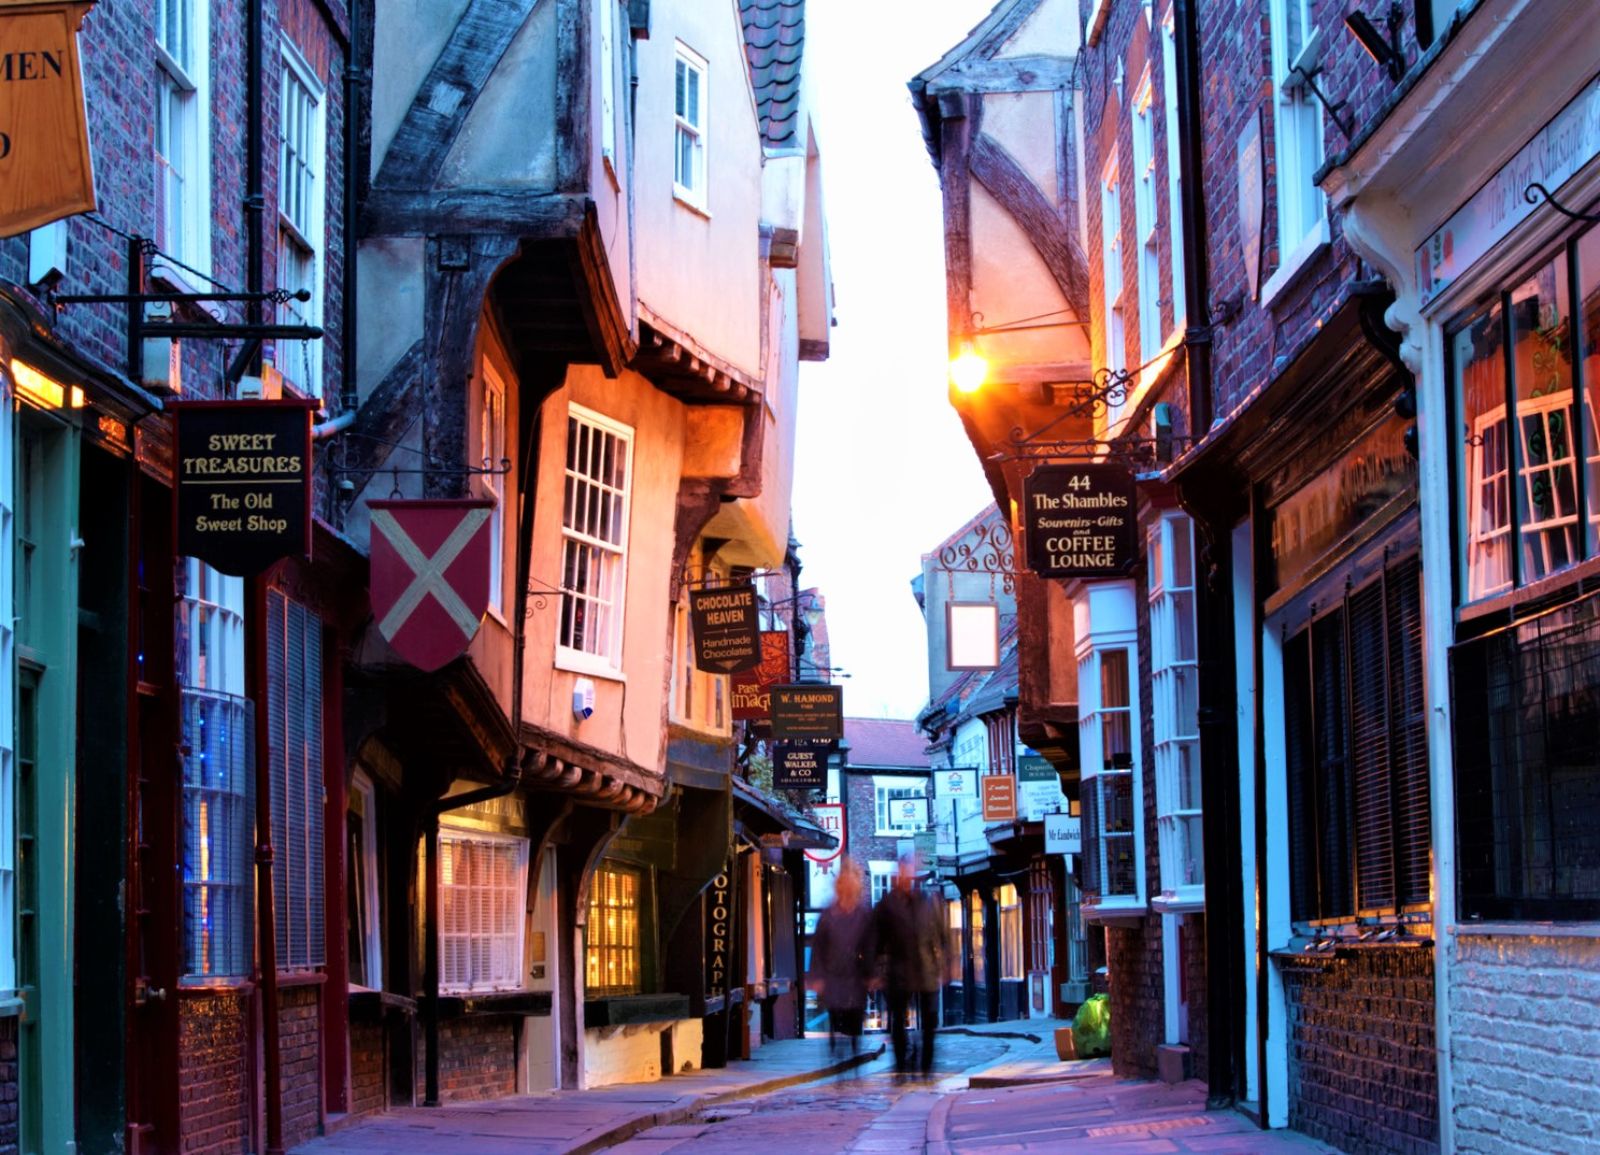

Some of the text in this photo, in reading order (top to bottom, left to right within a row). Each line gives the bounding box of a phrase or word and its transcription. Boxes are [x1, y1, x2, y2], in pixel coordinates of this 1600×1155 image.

[208, 434, 276, 450] SWEET
[184, 457, 301, 473] TREASURES
[1068, 475, 1091, 491] 44
[210, 492, 273, 509] The Old
[1032, 492, 1128, 510] The Shambles
[195, 514, 288, 534] Sweet Shop
[1046, 535, 1116, 553] COFFEE
[1050, 553, 1115, 569] LOUNGE
[697, 593, 752, 610] CHOCOLATE
[707, 609, 744, 626] HEAVEN
[703, 636, 752, 648] Handmade
[703, 648, 753, 659] Chocolates
[737, 684, 760, 694] Past
[794, 694, 834, 703] HAMOND
[787, 752, 814, 760] GUEST
[784, 760, 817, 769] WALKER
[790, 768, 812, 777] & CO
